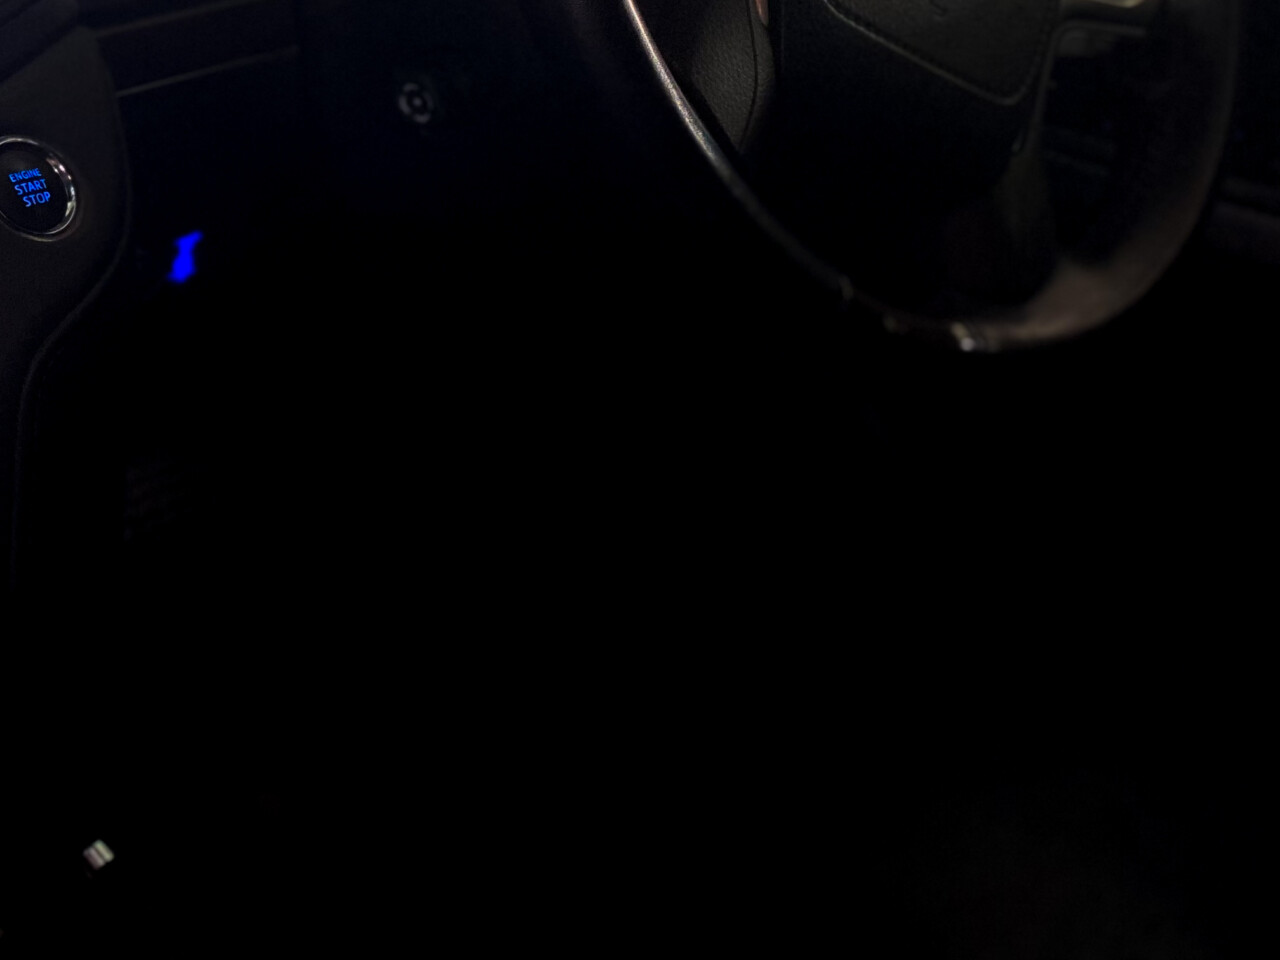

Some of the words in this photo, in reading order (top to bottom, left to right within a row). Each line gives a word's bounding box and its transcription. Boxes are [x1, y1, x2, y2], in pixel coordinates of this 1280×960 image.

[8, 167, 42, 183] ENGINE
[14, 178, 47, 196] START
[22, 191, 51, 208] STOP
